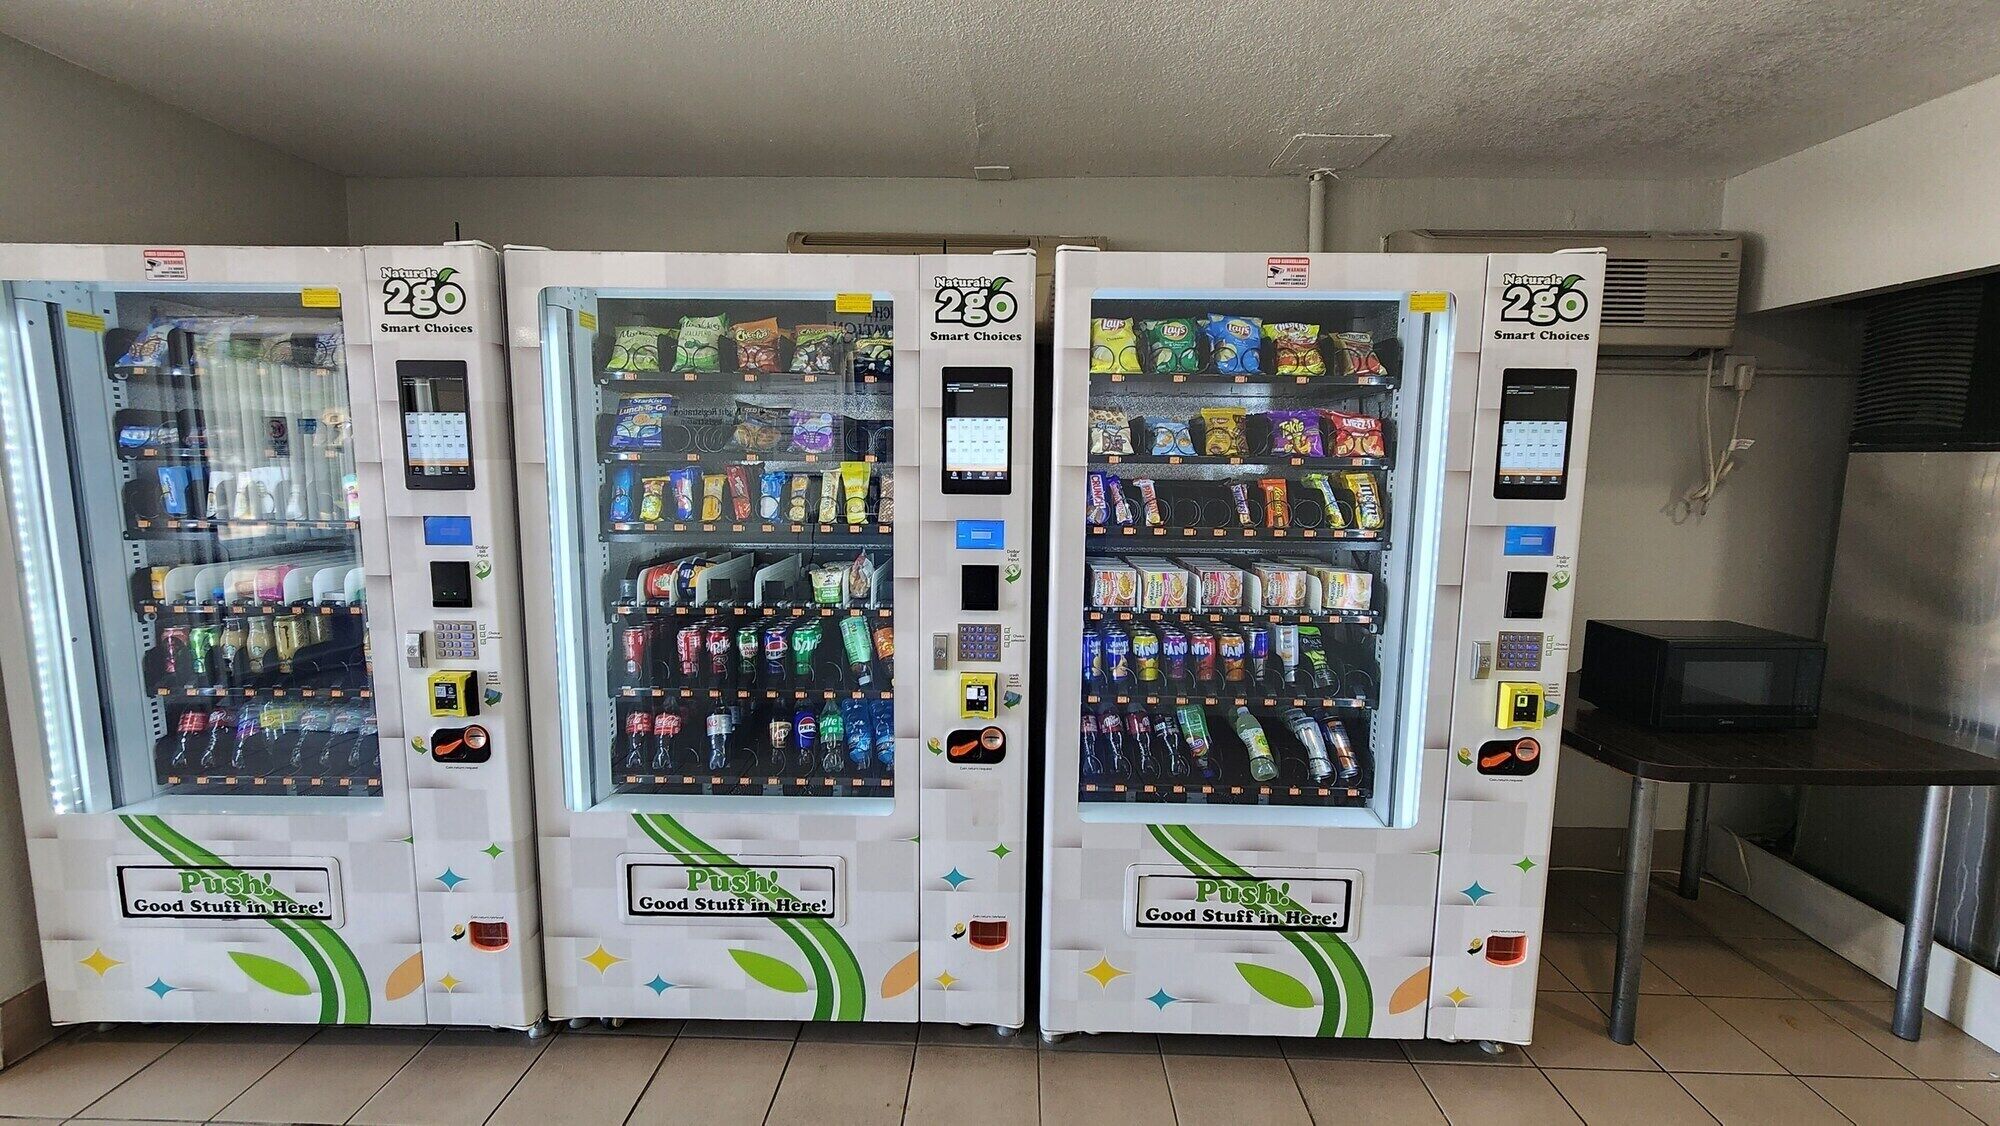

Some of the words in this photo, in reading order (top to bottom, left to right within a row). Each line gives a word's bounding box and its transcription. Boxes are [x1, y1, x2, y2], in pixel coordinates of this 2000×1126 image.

[381, 267, 438, 278] Naturals
[1503, 273, 1562, 285] Naturals
[935, 276, 991, 288] Naturals
[383, 278, 466, 319] 2go
[1501, 284, 1588, 326] 2go
[935, 287, 1018, 327] 2go
[381, 323, 420, 333] Smart
[424, 323, 473, 333] Choices
[1162, 325, 1186, 337] Lay's
[1494, 330, 1535, 340] Smart
[1540, 331, 1590, 341] Choices
[930, 332, 969, 341] Smart
[973, 332, 1022, 341] Choices
[1279, 420, 1304, 438] Takis
[1091, 475, 1105, 508] CRUNCH
[178, 871, 274, 895] Push!
[686, 869, 779, 893] Push!
[1196, 880, 1290, 905] Push!
[134, 899, 184, 912] Good
[190, 900, 241, 913] Stuff
[247, 901, 267, 913] in
[273, 901, 324, 913] Here!
[639, 897, 689, 911] Good
[694, 897, 745, 911] Stuff
[751, 898, 770, 911] in
[776, 899, 827, 912] Here!
[1146, 908, 1196, 922] Good
[1202, 909, 1254, 923] Stuff
[1259, 911, 1279, 924] in
[1286, 912, 1338, 925] Here!
